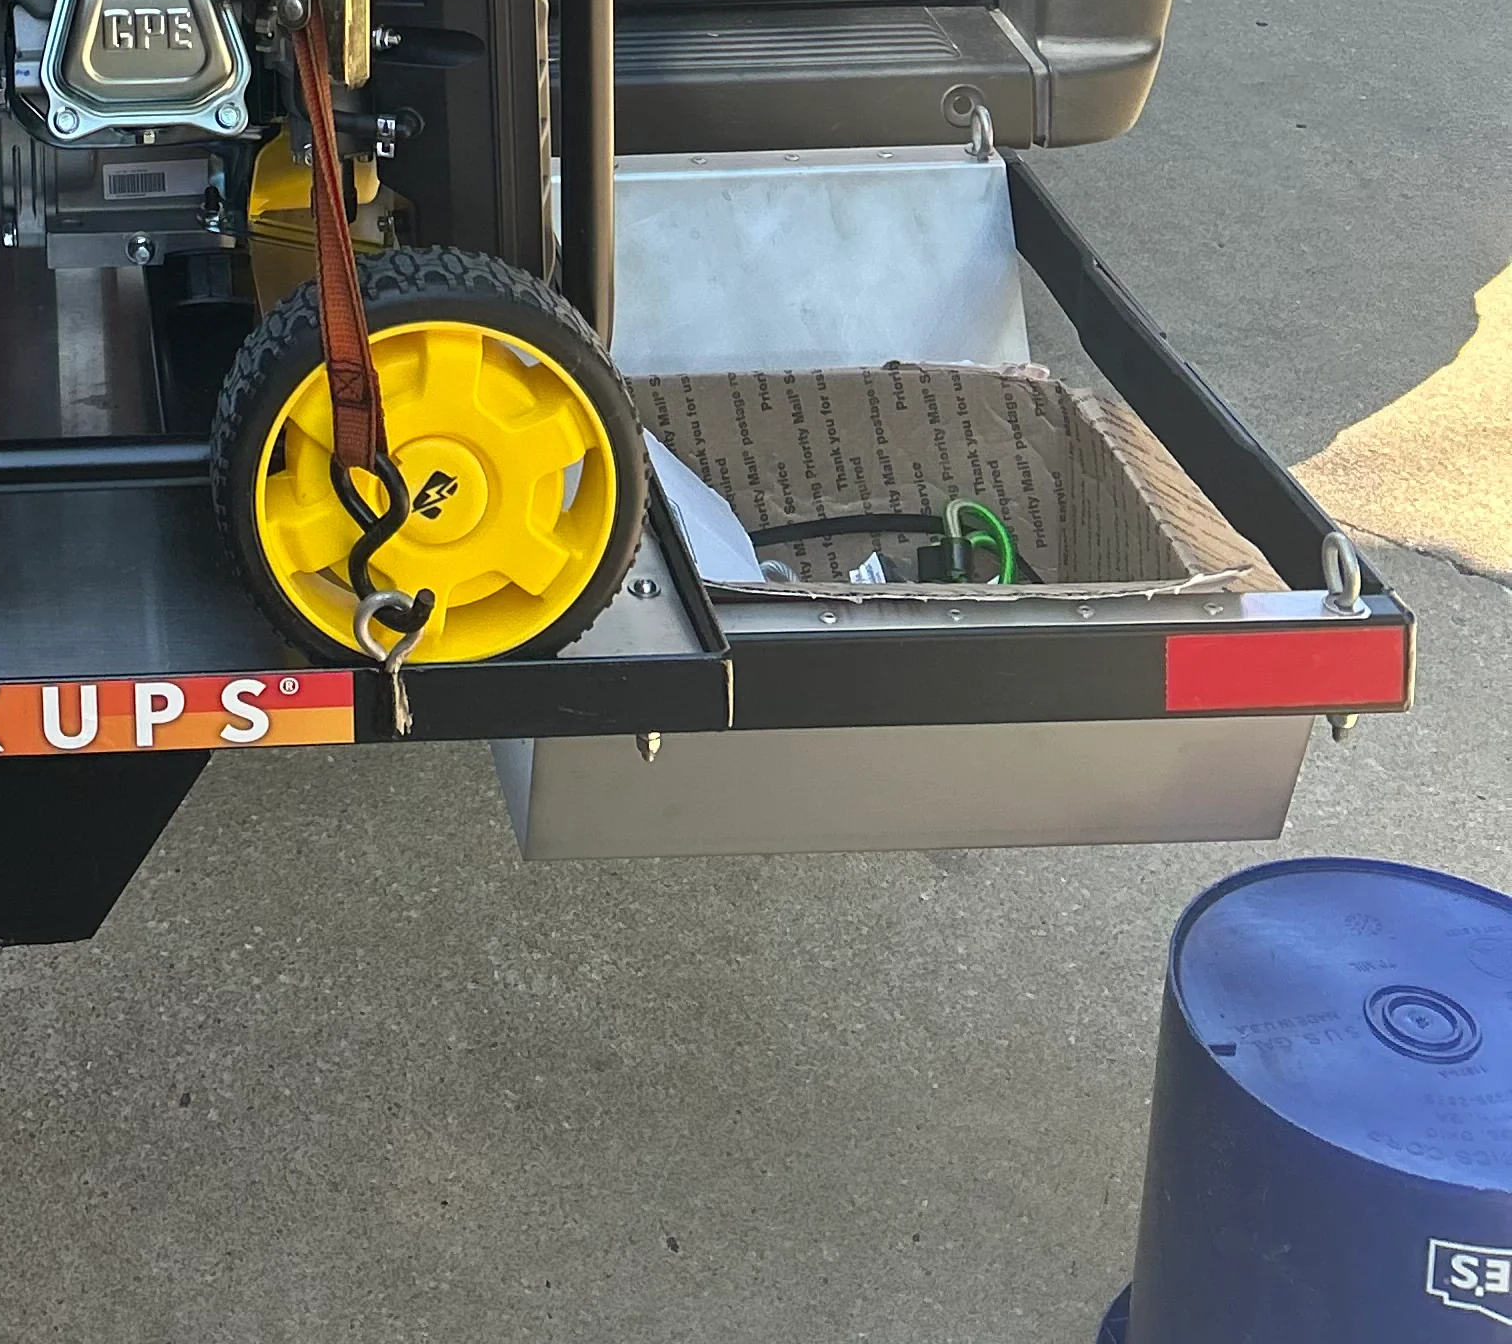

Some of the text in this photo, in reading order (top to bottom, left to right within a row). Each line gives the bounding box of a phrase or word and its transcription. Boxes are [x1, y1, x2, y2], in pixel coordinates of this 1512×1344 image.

[684, 397, 697, 417] for
[730, 390, 753, 446] postage
[818, 395, 832, 415] for
[866, 388, 888, 445] postage
[956, 395, 969, 416] for
[1003, 392, 1028, 449] postage
[689, 420, 706, 446] you
[796, 428, 817, 479] Priority
[825, 418, 841, 444] you
[963, 419, 978, 446] you
[695, 447, 712, 482] hank
[829, 447, 849, 492] Thank
[933, 428, 955, 481] Priority
[969, 449, 986, 495] Thank
[777, 461, 796, 515] Service
[987, 459, 1013, 521] required
[1027, 495, 1048, 548] Priority
[827, 551, 843, 578] you
